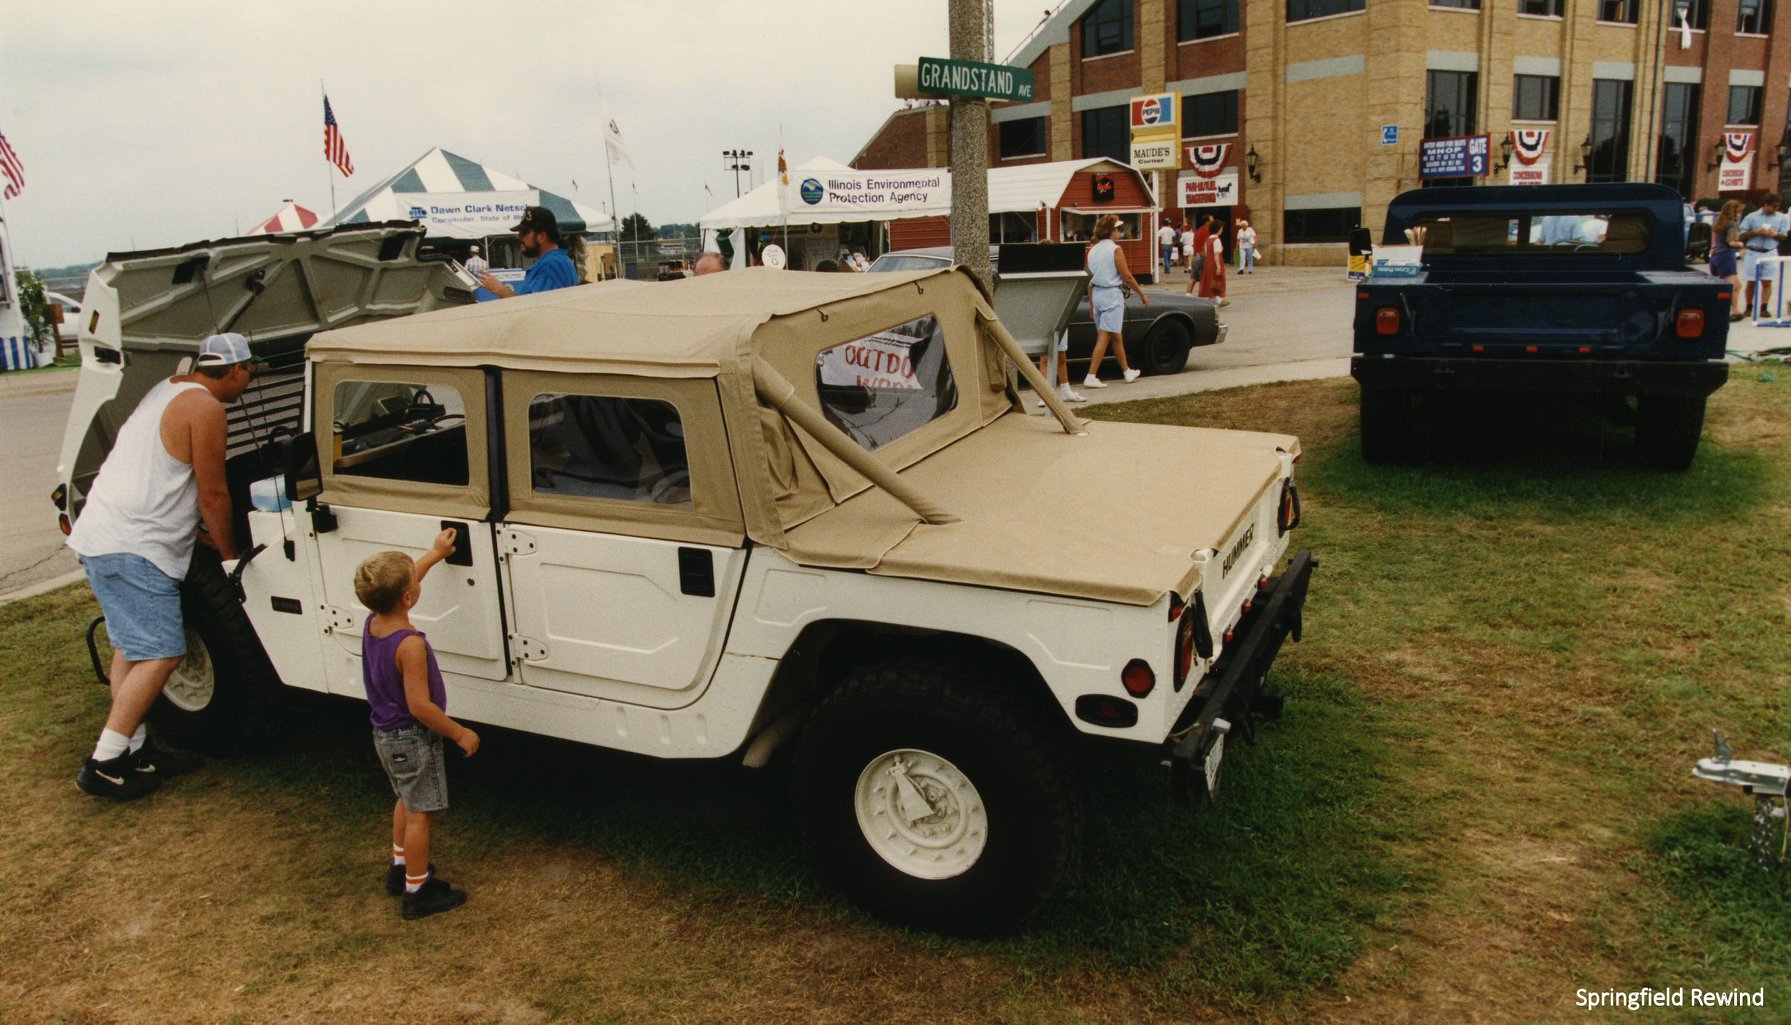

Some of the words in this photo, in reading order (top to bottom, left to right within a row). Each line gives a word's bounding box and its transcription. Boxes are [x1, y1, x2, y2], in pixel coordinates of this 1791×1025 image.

[921, 63, 1013, 95] GRANDSTAND
[1018, 84, 1031, 97] AVE
[1143, 107, 1160, 115] PEPSI
[1134, 147, 1170, 158] MAUDE'S
[1470, 138, 1486, 154] GATE
[1473, 156, 1482, 172] 3
[828, 180, 862, 190] Illinois
[867, 177, 940, 190] Environmental
[829, 193, 884, 203] Protection
[890, 192, 928, 204] Agency
[431, 206, 460, 214] Dawn
[465, 204, 492, 213] Clark
[1222, 522, 1254, 580] HUMMER
